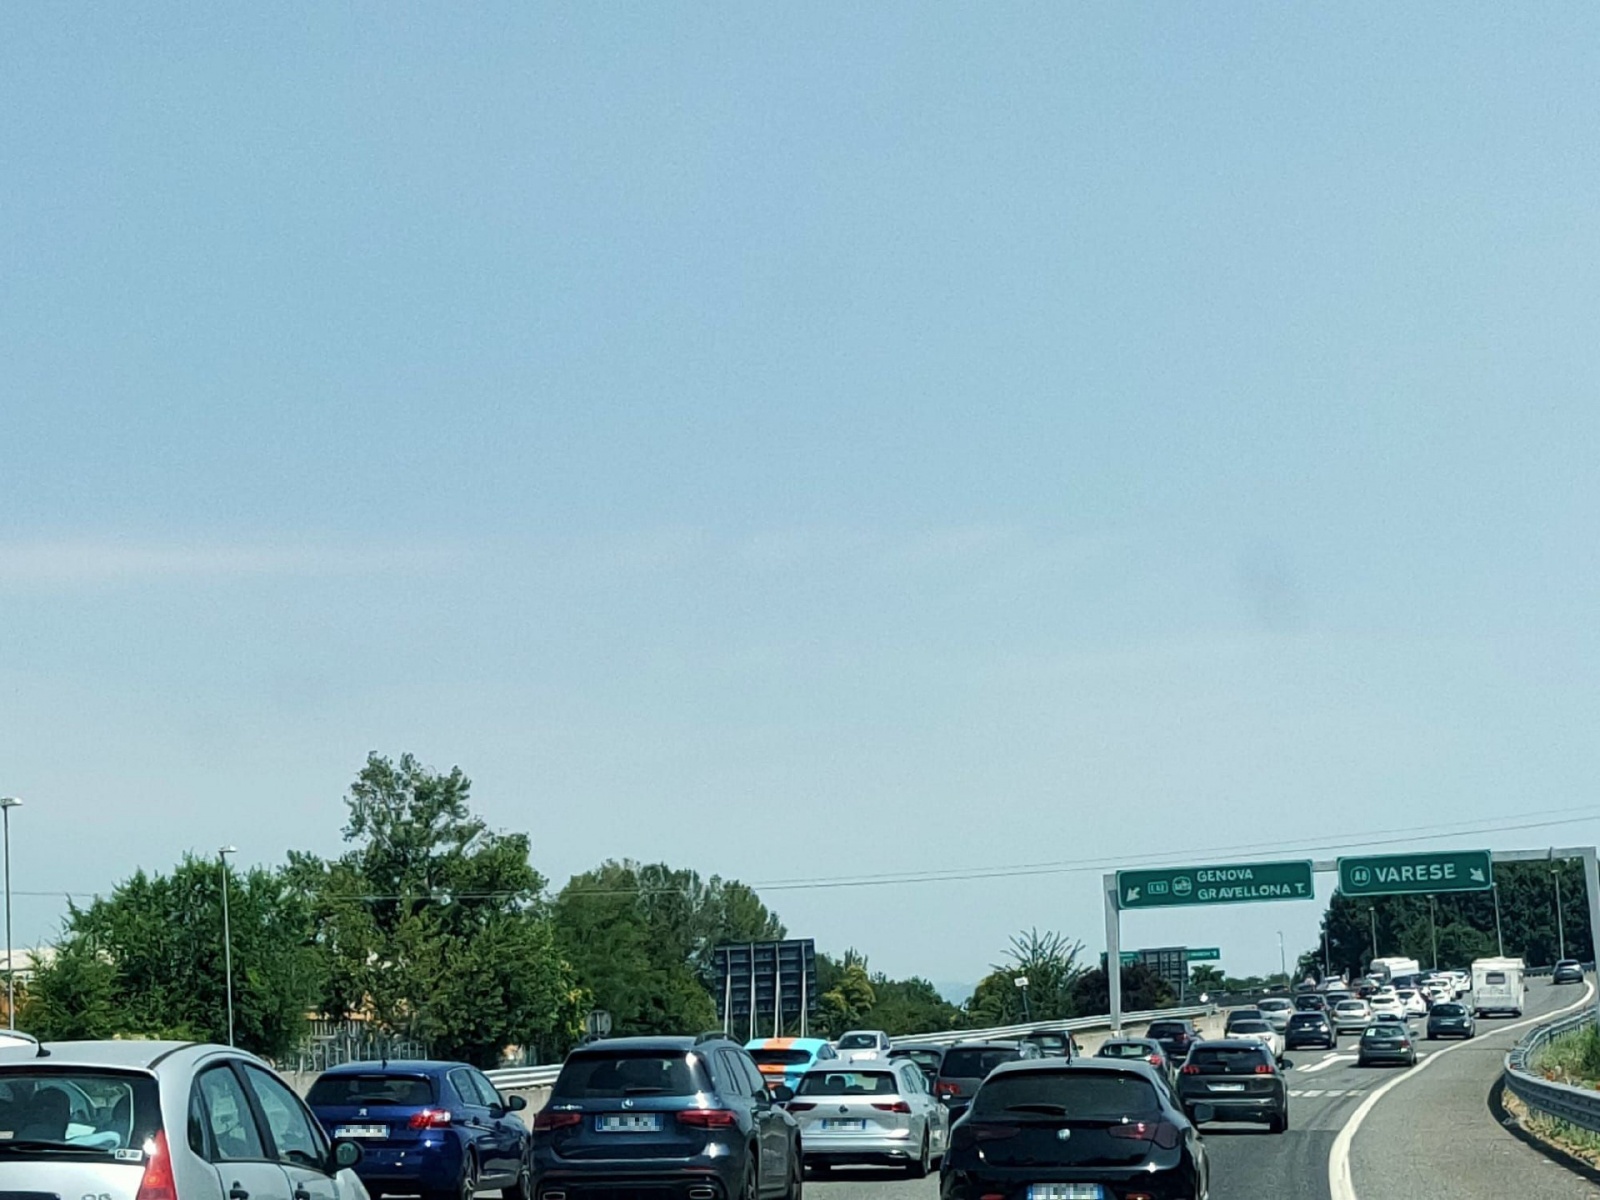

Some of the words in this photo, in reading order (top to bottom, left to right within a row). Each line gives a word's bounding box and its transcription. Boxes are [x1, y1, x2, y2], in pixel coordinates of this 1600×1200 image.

[1197, 869, 1253, 882] GENOVA
[1374, 863, 1457, 883] VARESE
[1197, 885, 1291, 900] GRAVELLONA
